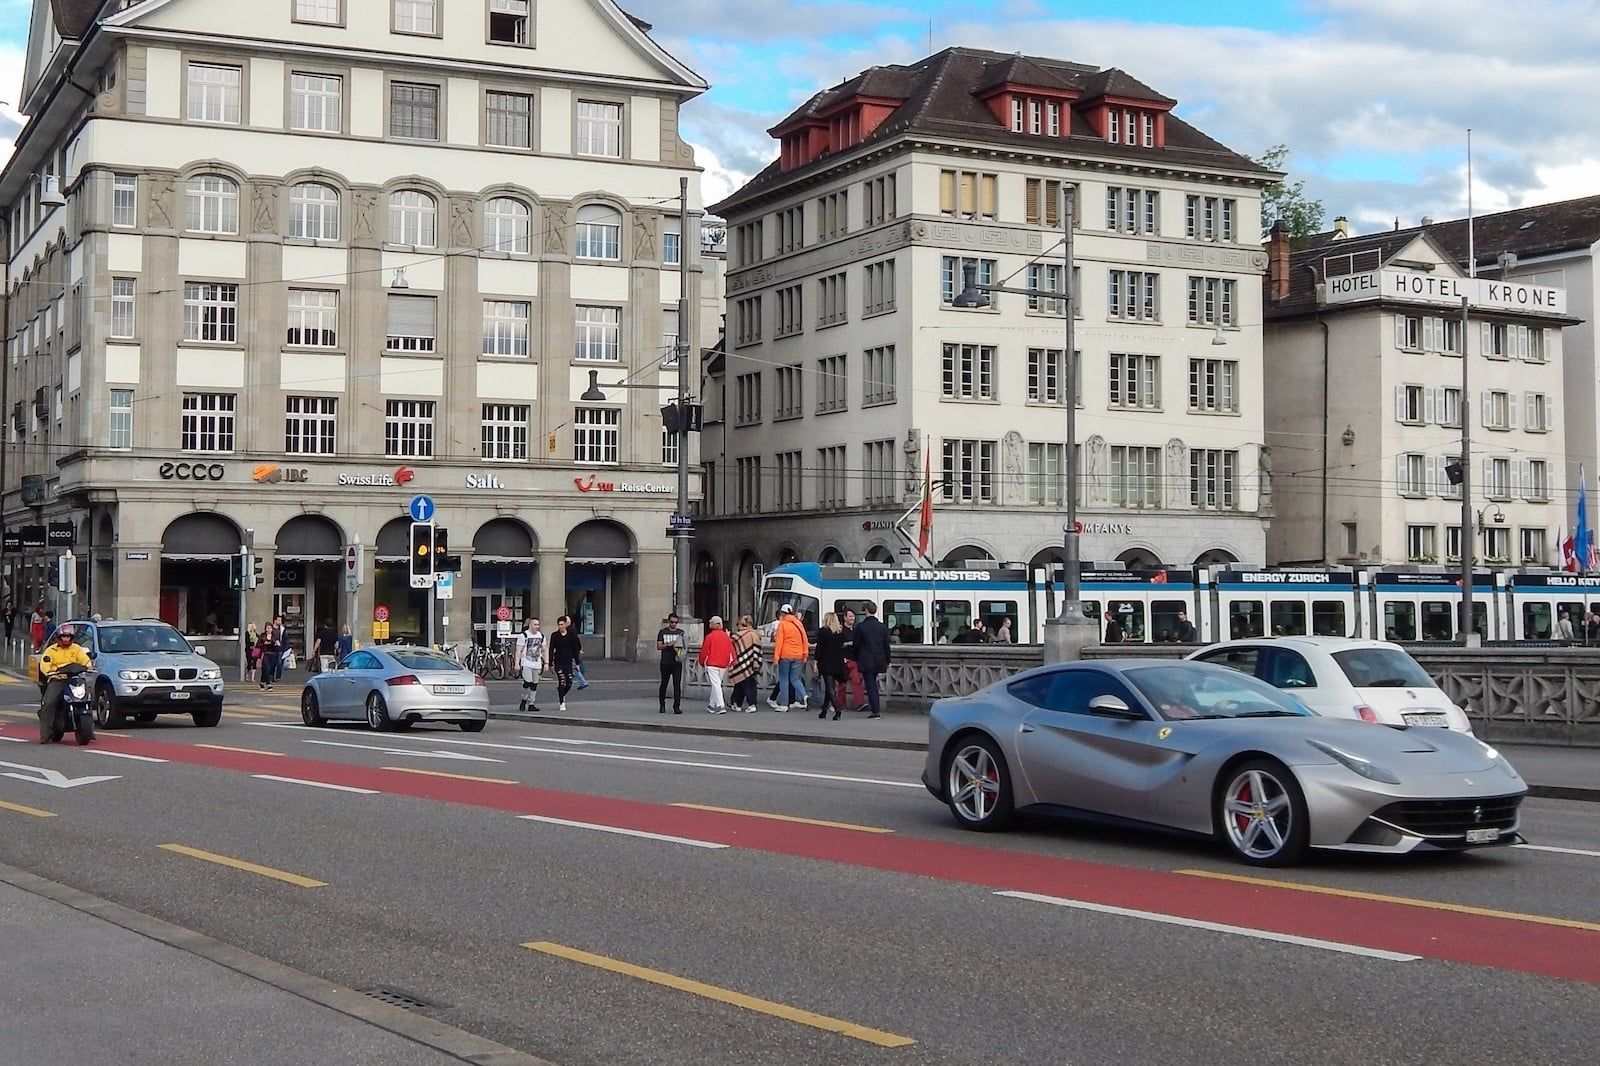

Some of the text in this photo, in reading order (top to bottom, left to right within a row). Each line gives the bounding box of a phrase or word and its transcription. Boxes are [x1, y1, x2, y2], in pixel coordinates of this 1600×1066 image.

[1332, 275, 1378, 294] HOTEL
[1396, 274, 1556, 307] HOTEL KRONE
[160, 462, 224, 481] ecco
[621, 481, 675, 493] ReiseCenter
[49, 530, 72, 538] ecco
[859, 569, 991, 582] HI LITTLE MONSTERS
[1241, 572, 1287, 583] ENERGY
[1546, 576, 1577, 586] HELLO
